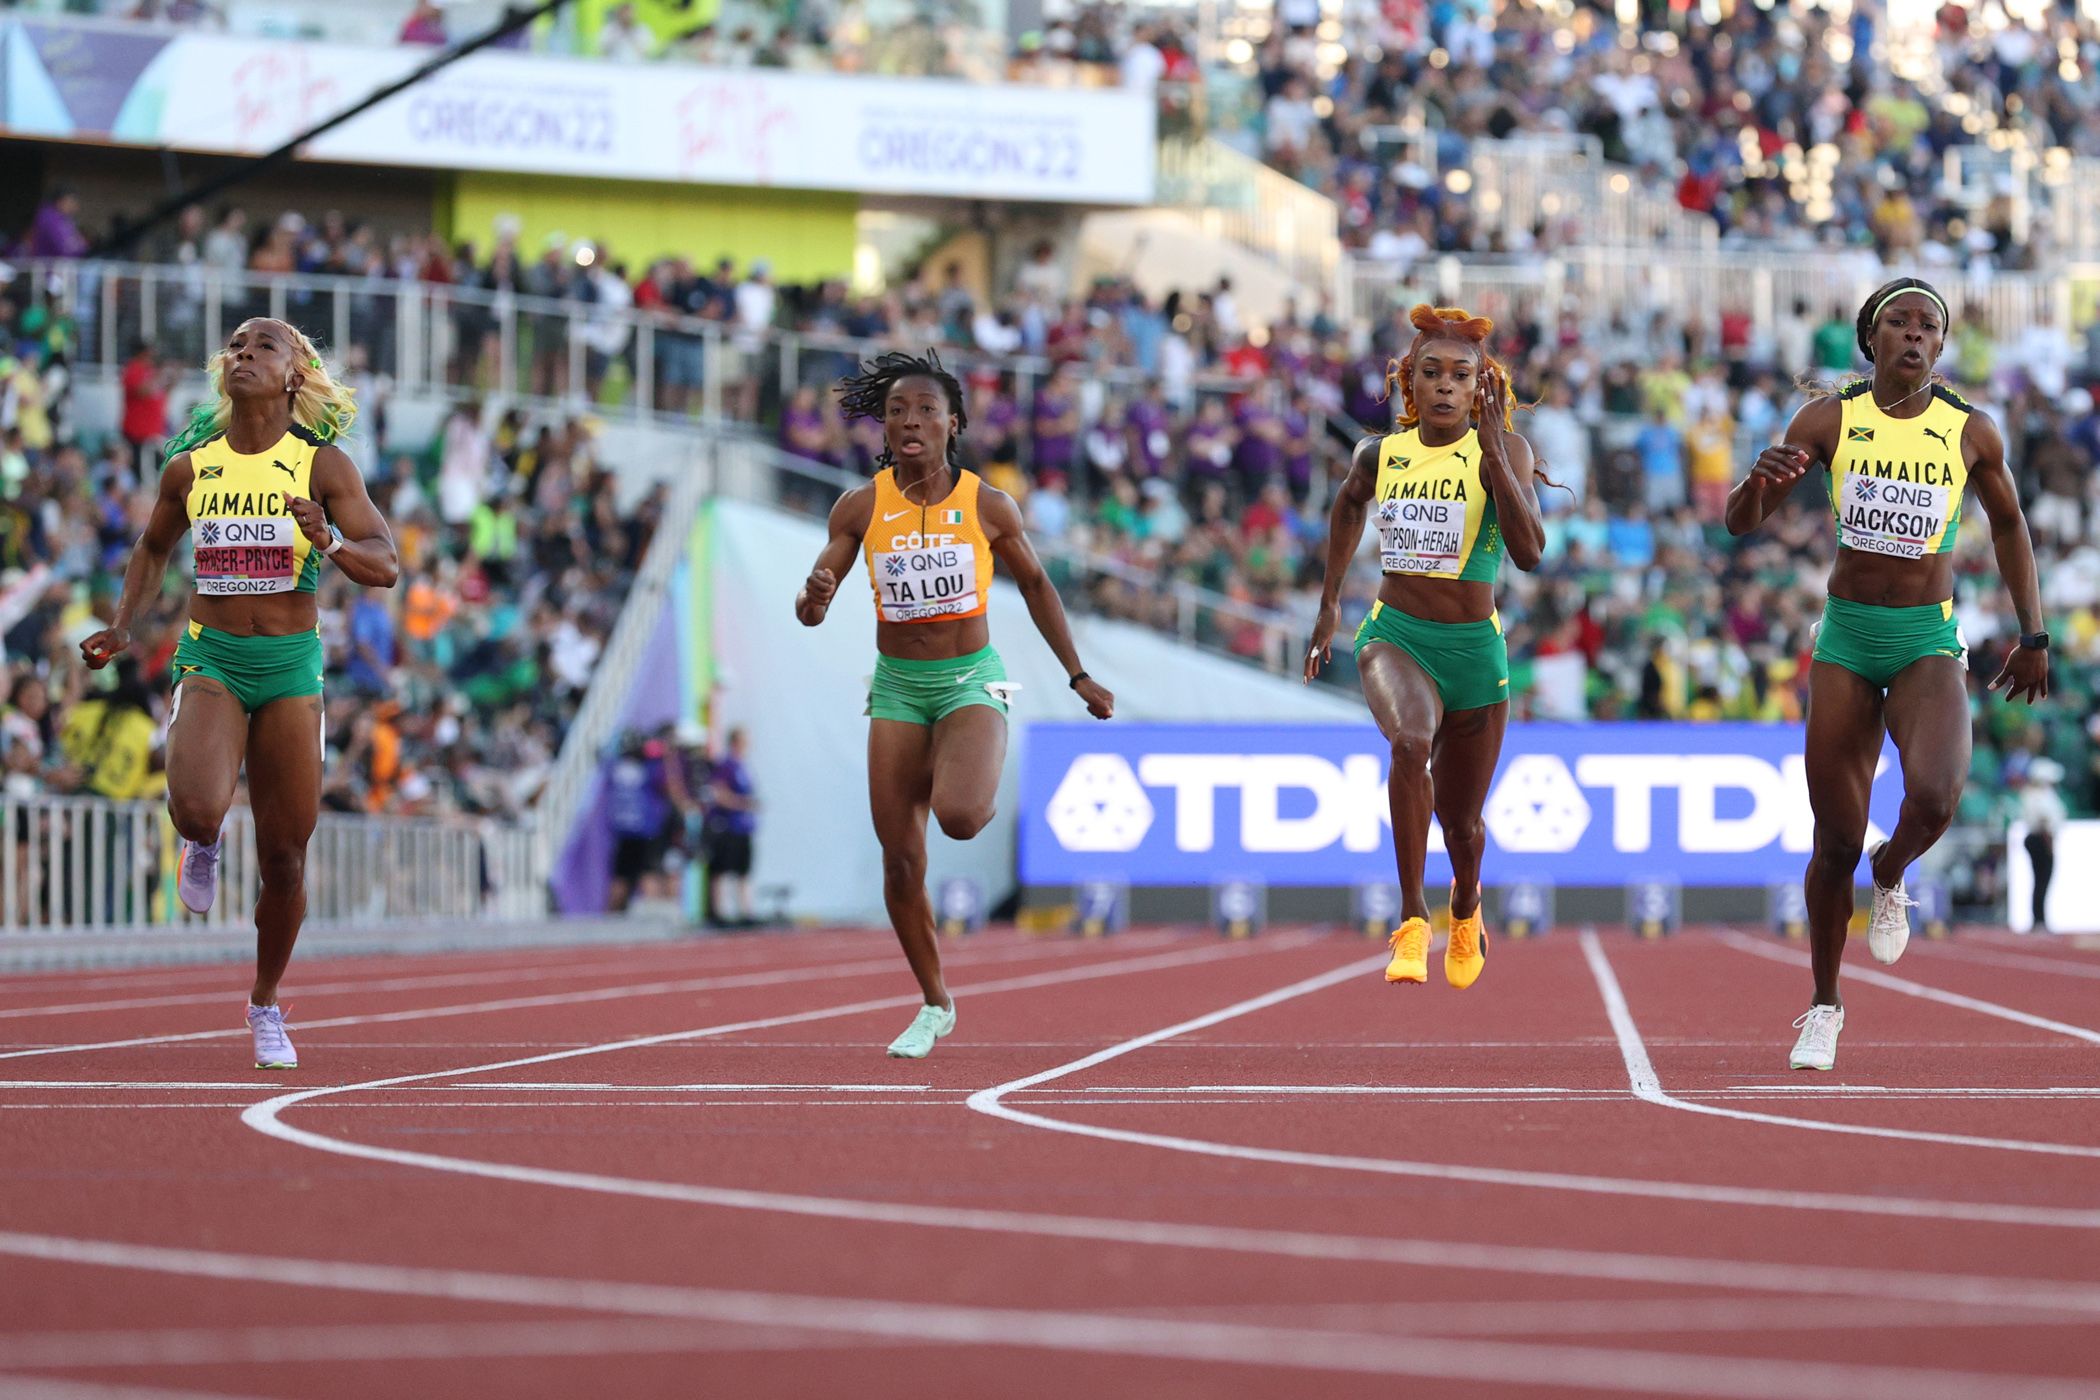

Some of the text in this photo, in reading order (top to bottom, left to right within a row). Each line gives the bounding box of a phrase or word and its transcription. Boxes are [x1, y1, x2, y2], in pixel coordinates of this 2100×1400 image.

[1850, 459, 1954, 485] JAMAICA
[1381, 479, 1467, 504] JAMAICA
[1882, 485, 1932, 508] QNB
[1402, 503, 1448, 523] QNB
[1845, 504, 1938, 538] JACKSON
[225, 523, 276, 541] QNB
[891, 530, 955, 551] CÔTE
[1380, 527, 1459, 553] TMPSON-HERAH
[1852, 535, 1923, 557] OREGON22
[911, 551, 958, 571] QNB
[1384, 557, 1441, 571] REGON22
[207, 580, 276, 592] OREGON22
[886, 574, 964, 602] TA LOU
[896, 602, 963, 620] OREGON22
